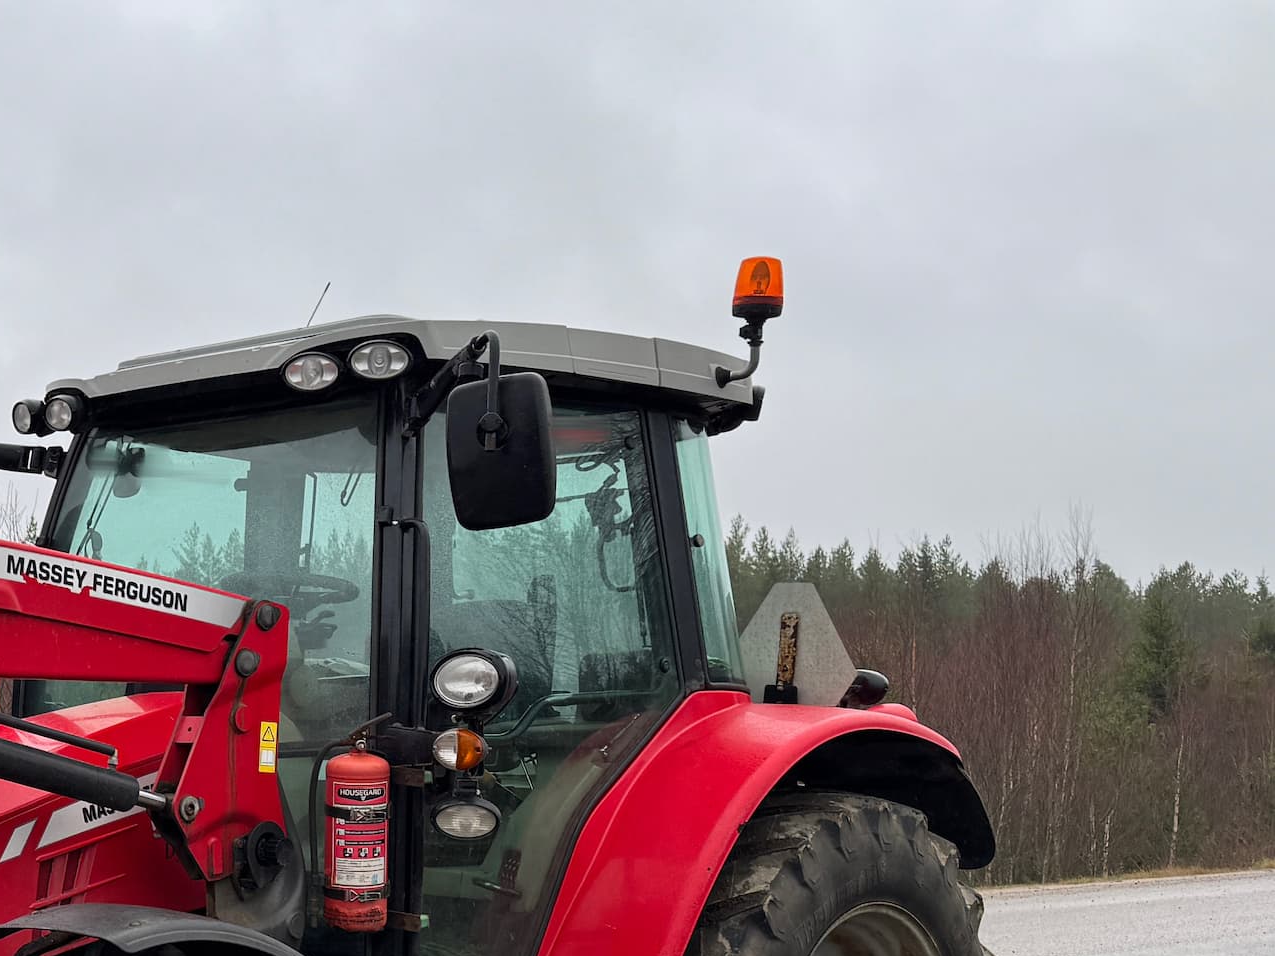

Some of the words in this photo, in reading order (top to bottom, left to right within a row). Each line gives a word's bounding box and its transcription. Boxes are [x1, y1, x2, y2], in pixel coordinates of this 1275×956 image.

[7, 555, 87, 589] MASSEY
[93, 574, 188, 612] FERGUSON
[339, 788, 382, 797] HOUSEGARD
